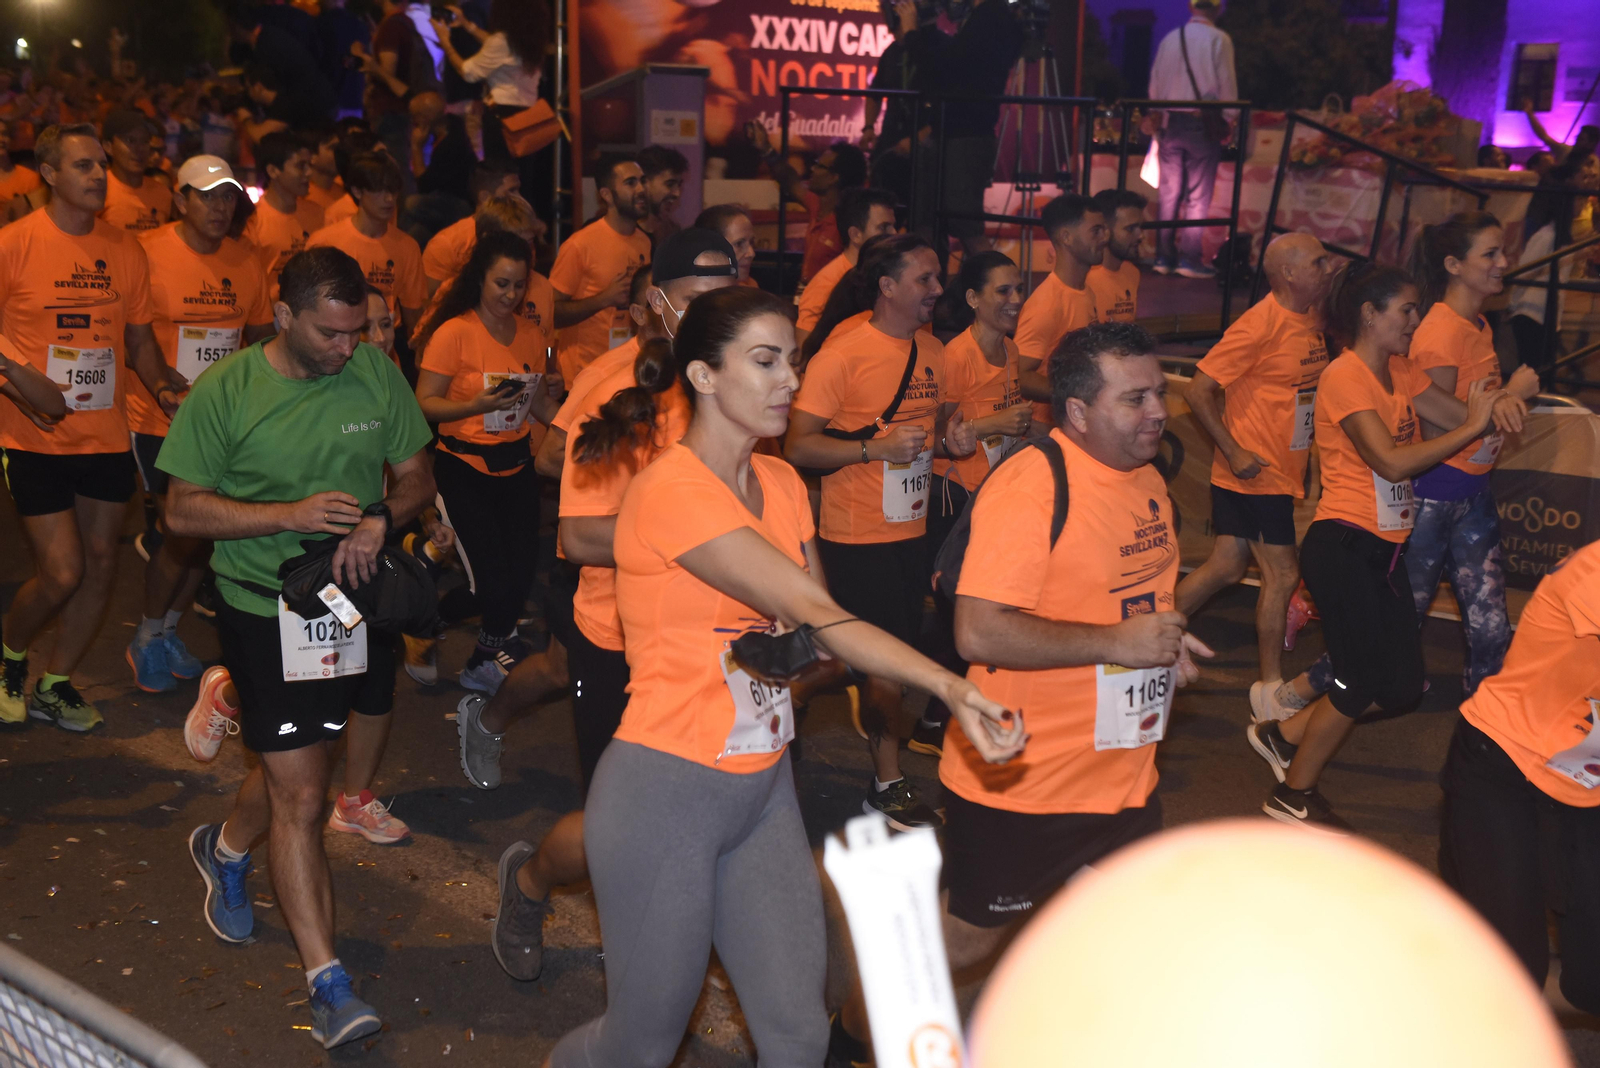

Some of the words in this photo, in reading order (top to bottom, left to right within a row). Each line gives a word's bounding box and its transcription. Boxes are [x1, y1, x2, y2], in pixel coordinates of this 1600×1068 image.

[750, 14, 838, 54] XXXIV
[839, 21, 895, 58] CAR
[751, 59, 878, 100] NOCTU
[54, 280, 88, 289] SEVILLA
[70, 272, 112, 282] NOCTURNA
[183, 297, 217, 306] SEVILLA
[200, 290, 237, 299] NOCTURNA
[66, 368, 106, 385] 15608
[902, 390, 924, 401] VILLA
[341, 422, 359, 434] Life
[360, 422, 369, 431] Is
[369, 419, 382, 430] On
[1304, 411, 1315, 427] 21
[1133, 521, 1168, 541] NOCTURNA
[1119, 541, 1154, 557] SEVILLA
[1500, 536, 1576, 560] NTAMIE
